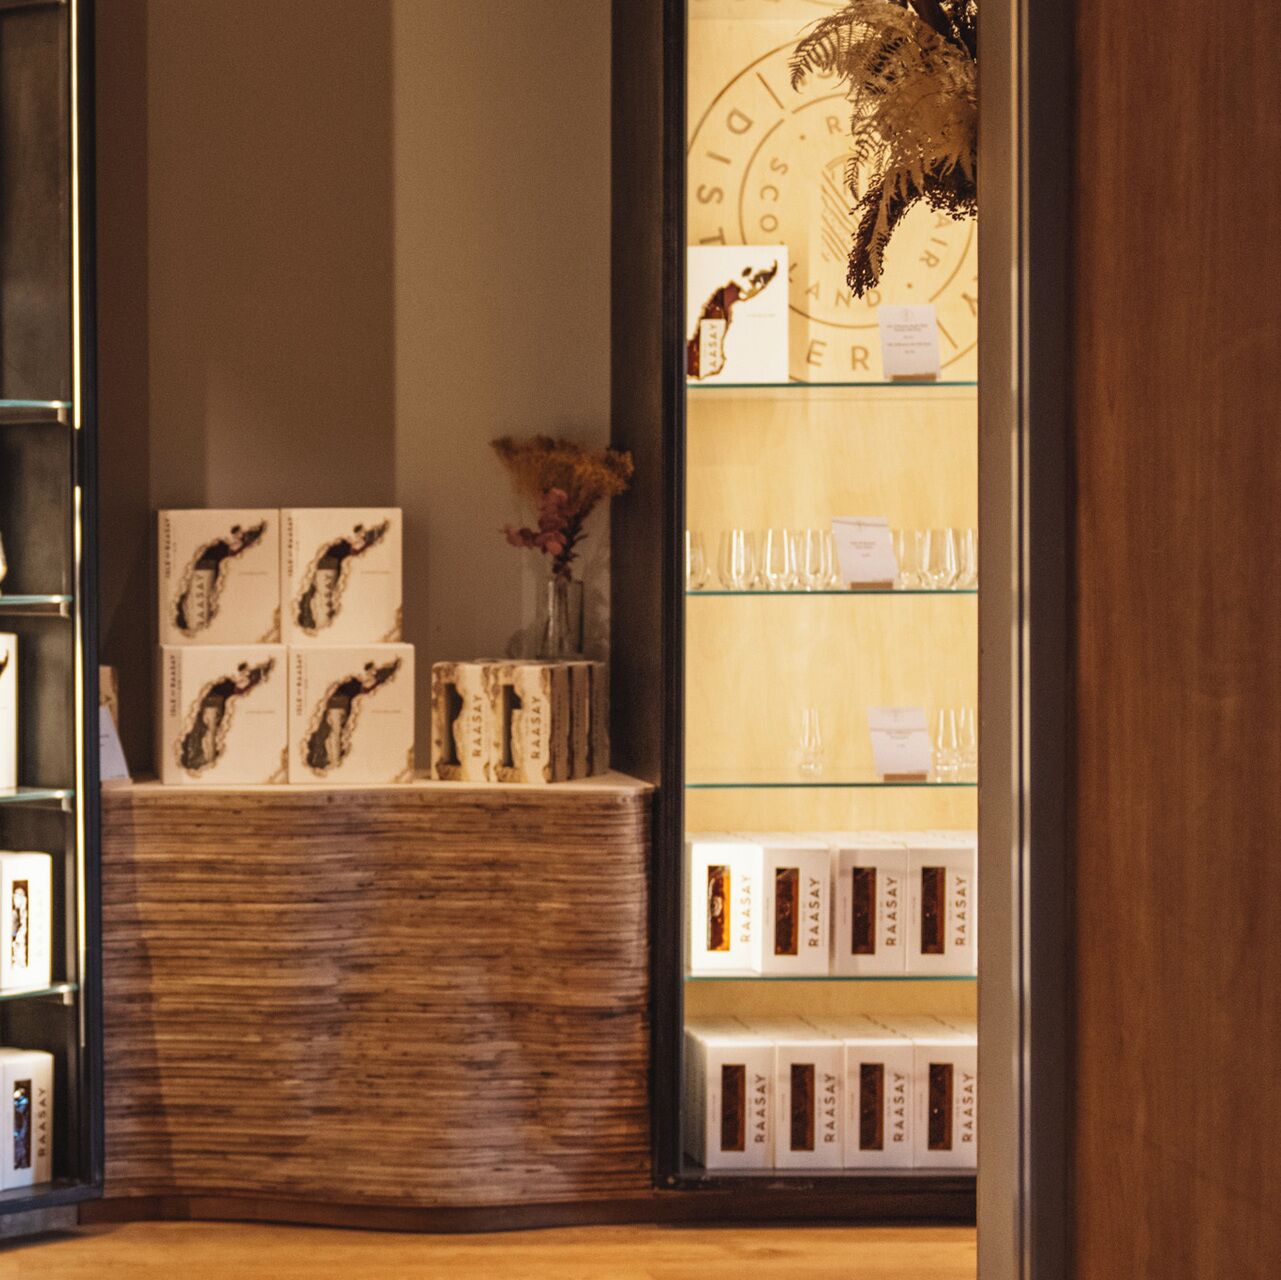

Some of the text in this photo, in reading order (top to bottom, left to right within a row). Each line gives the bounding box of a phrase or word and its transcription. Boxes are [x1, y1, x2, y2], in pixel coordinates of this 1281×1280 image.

[472, 695, 482, 757] RAASAY
[531, 696, 541, 759] RAASAY
[740, 874, 751, 943] RAASAY
[808, 877, 820, 947] RAASAY
[886, 877, 897, 946] RAASAY
[955, 877, 967, 946] RAASAY
[38, 1087, 47, 1157] RAASAY
[755, 1074, 766, 1143] RAASAY
[824, 1073, 836, 1143] RAASAY
[893, 1073, 905, 1142] RAASAY
[962, 1073, 974, 1142] RAASAY
